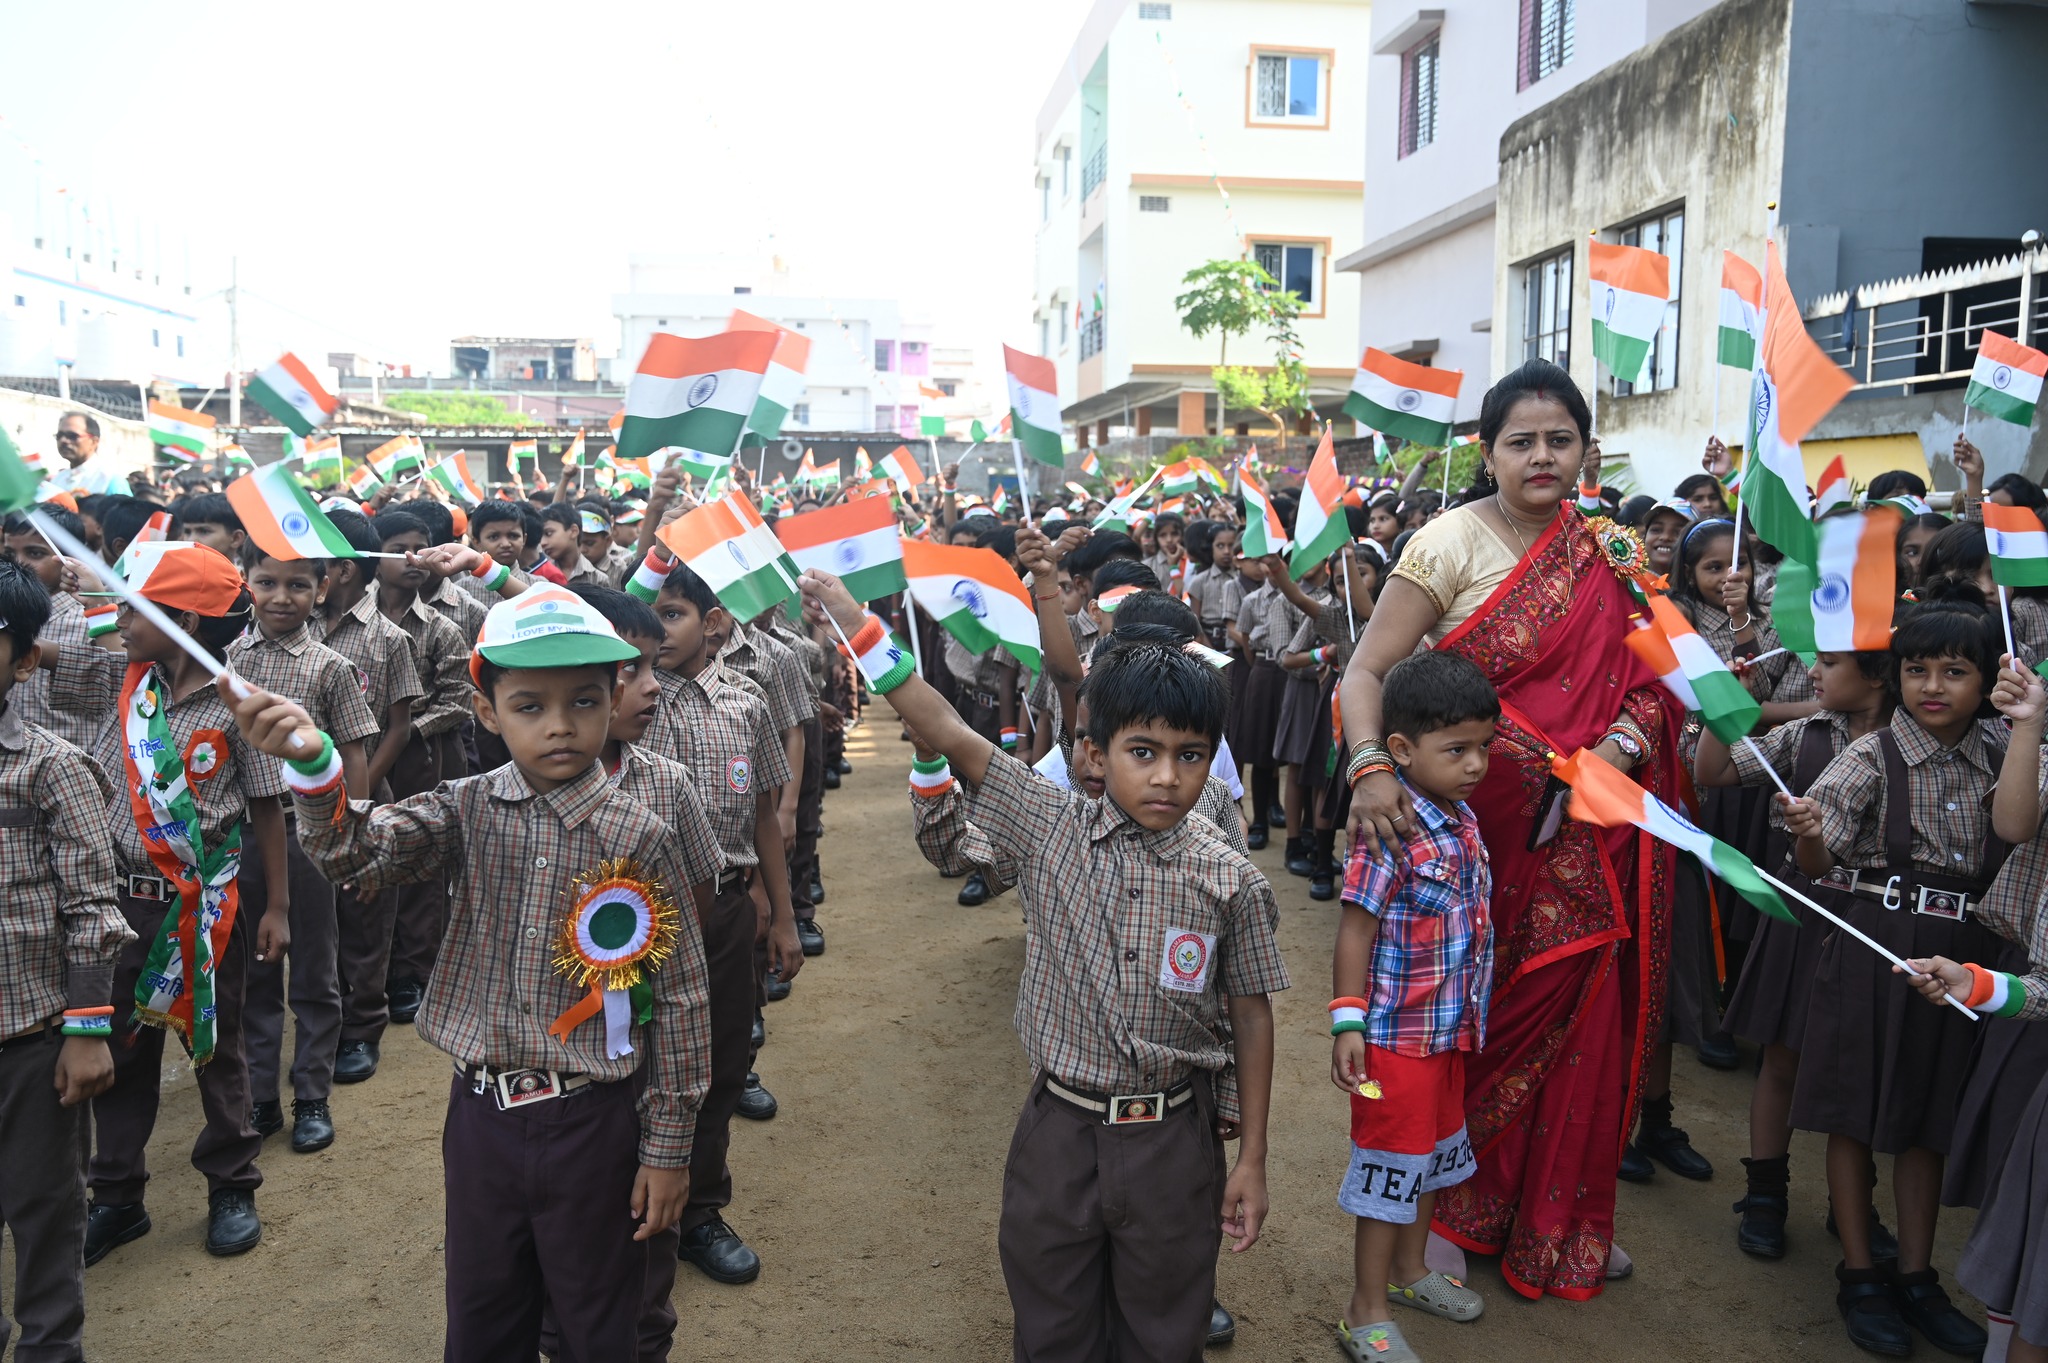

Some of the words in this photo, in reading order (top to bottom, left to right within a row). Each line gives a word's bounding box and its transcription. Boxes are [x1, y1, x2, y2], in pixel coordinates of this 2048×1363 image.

[517, 627, 545, 638] LOVE
[204, 884, 220, 893] OVE
[1169, 937, 1185, 962] RAJKAMAL
[1184, 934, 1204, 947] CONCEPT
[519, 1070, 537, 1078] CONCEPT
[520, 1089, 544, 1100] JAMUI
